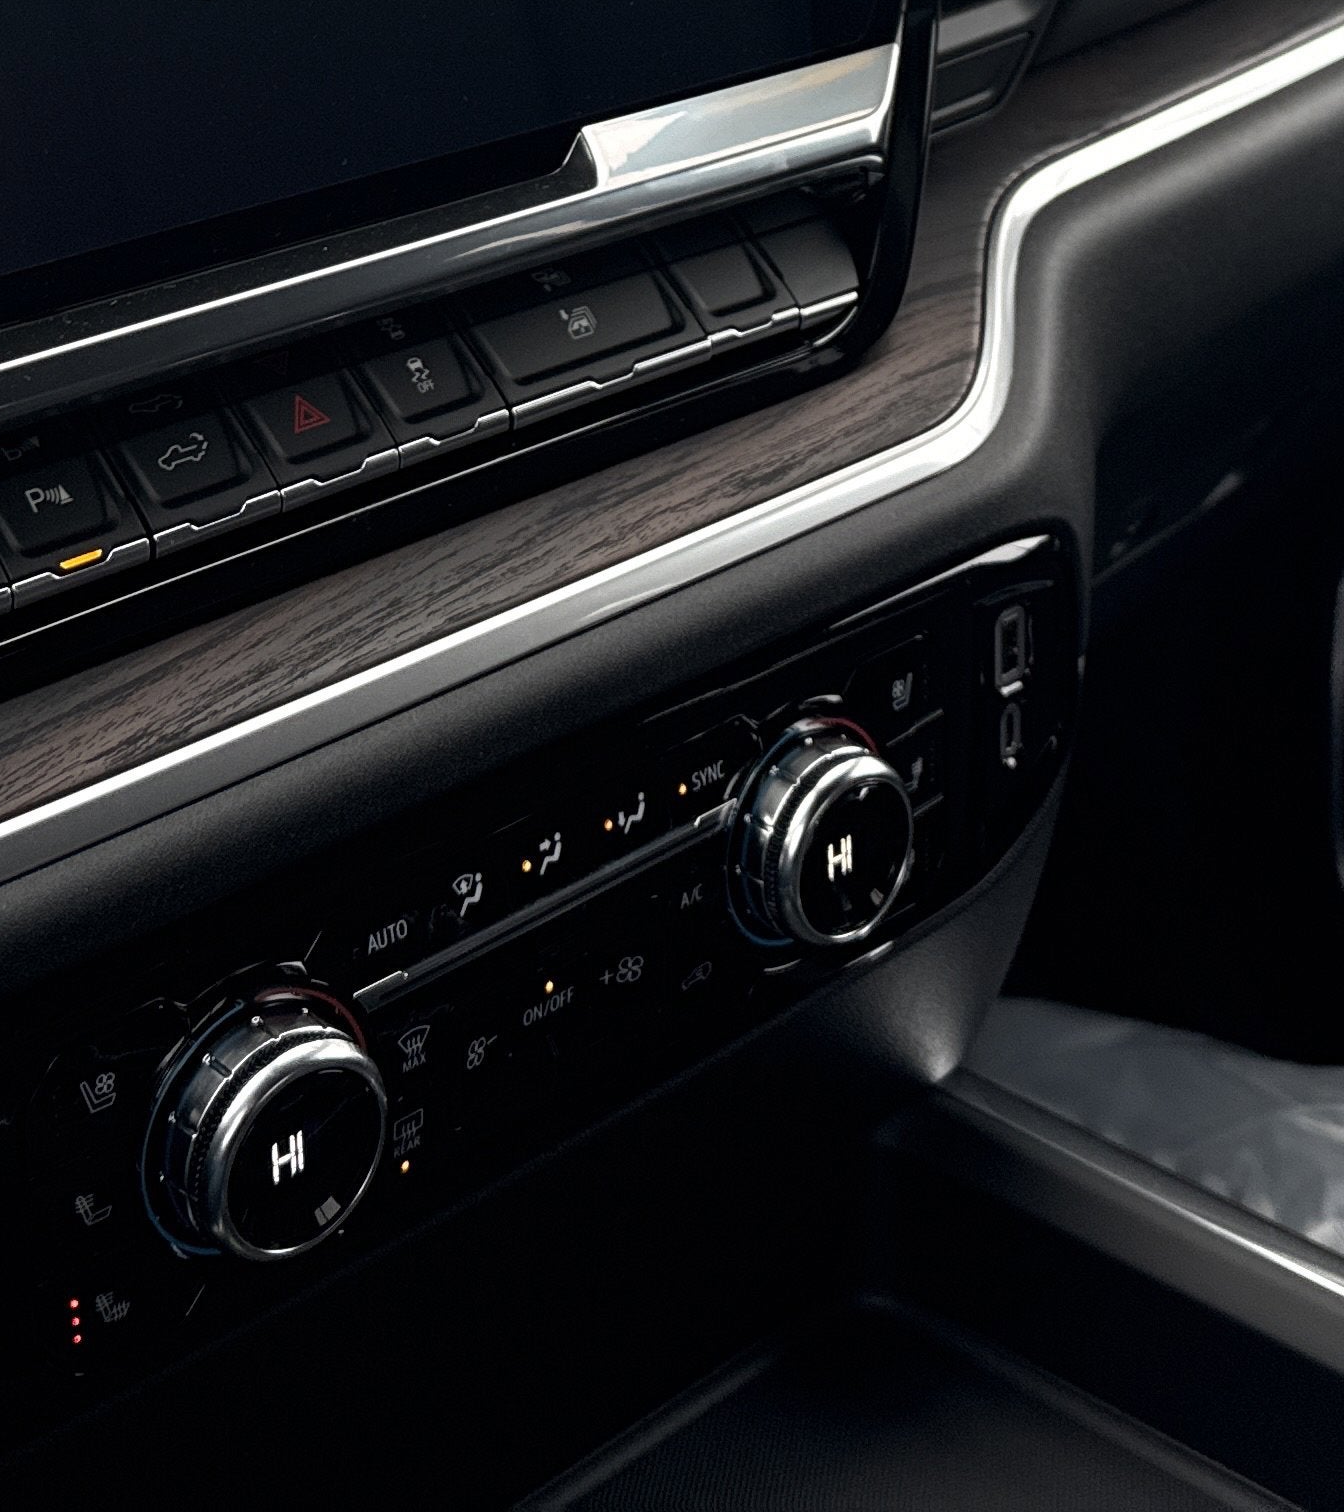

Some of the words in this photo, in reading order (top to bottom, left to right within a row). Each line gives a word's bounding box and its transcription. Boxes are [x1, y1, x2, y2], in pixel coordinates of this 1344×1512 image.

[691, 759, 725, 792] SYNC
[827, 833, 853, 883] HI
[680, 882, 703, 910] A/C
[367, 919, 408, 955] AUTO
[523, 985, 575, 1027] ON/OFF
[402, 1052, 426, 1074] MAX
[271, 1129, 304, 1185] HI
